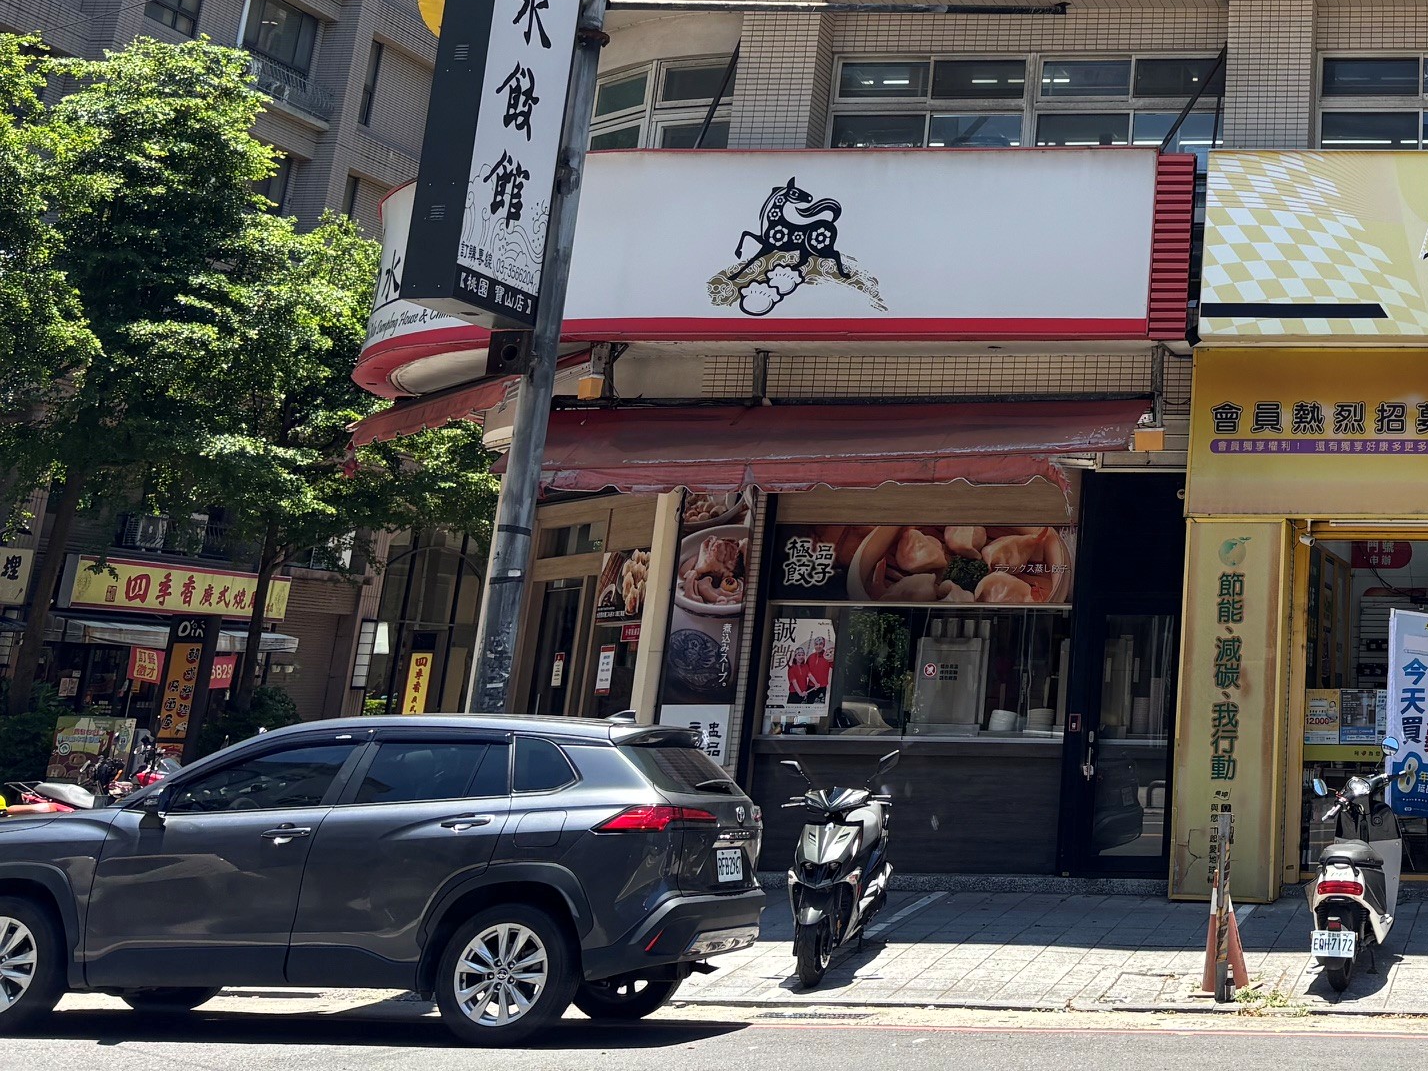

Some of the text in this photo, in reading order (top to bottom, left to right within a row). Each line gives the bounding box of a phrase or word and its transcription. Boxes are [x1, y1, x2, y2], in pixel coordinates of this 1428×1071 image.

[1210, 571, 1245, 781] 節能、減碳、我行動
[1400, 658, 1428, 745] 今天買
[1313, 938, 1353, 953] EQH-7172
